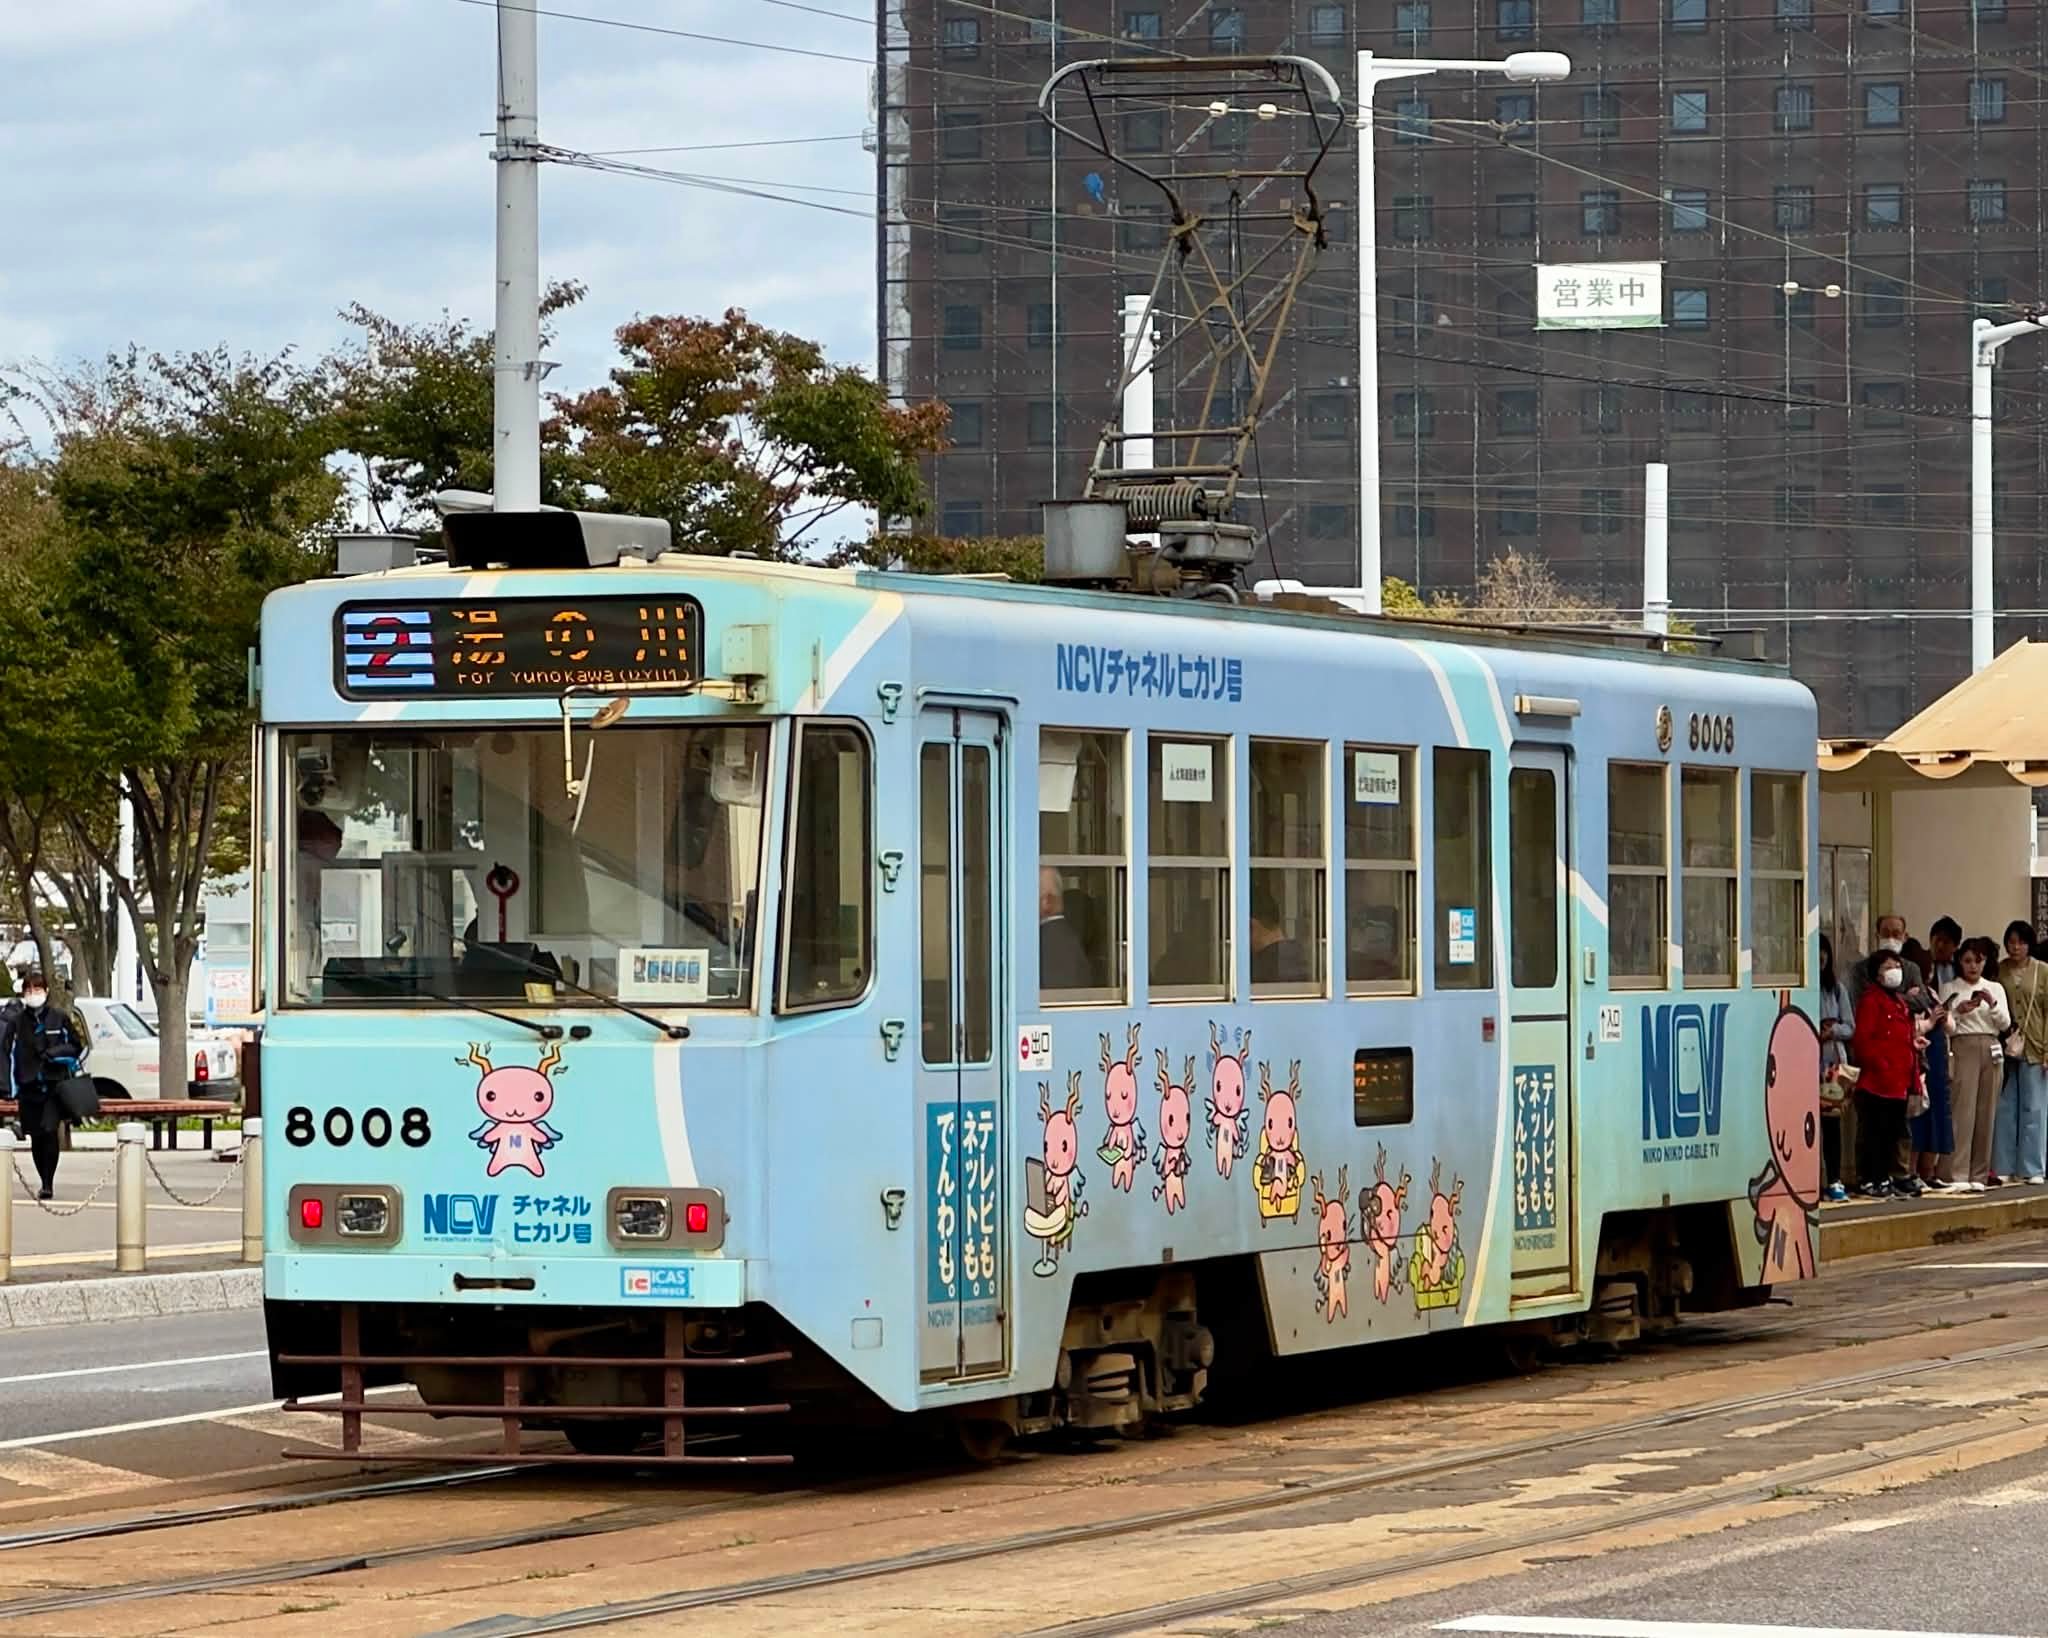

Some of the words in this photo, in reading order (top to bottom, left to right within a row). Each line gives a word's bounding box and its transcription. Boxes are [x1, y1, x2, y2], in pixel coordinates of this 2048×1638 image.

[1553, 277, 1645, 308] 営業中
[1056, 643, 1242, 703] NCVチャネルヒカリ号
[1688, 712, 1735, 755] 8008
[1031, 1031, 1050, 1055] 出口
[1641, 1003, 1731, 1141] NCV
[285, 1106, 432, 1148] 8008
[424, 1193, 500, 1236] NCV
[512, 1194, 592, 1217] チャネル
[513, 1222, 592, 1245] ヒカリ号
[651, 1269, 686, 1286] ICAS
